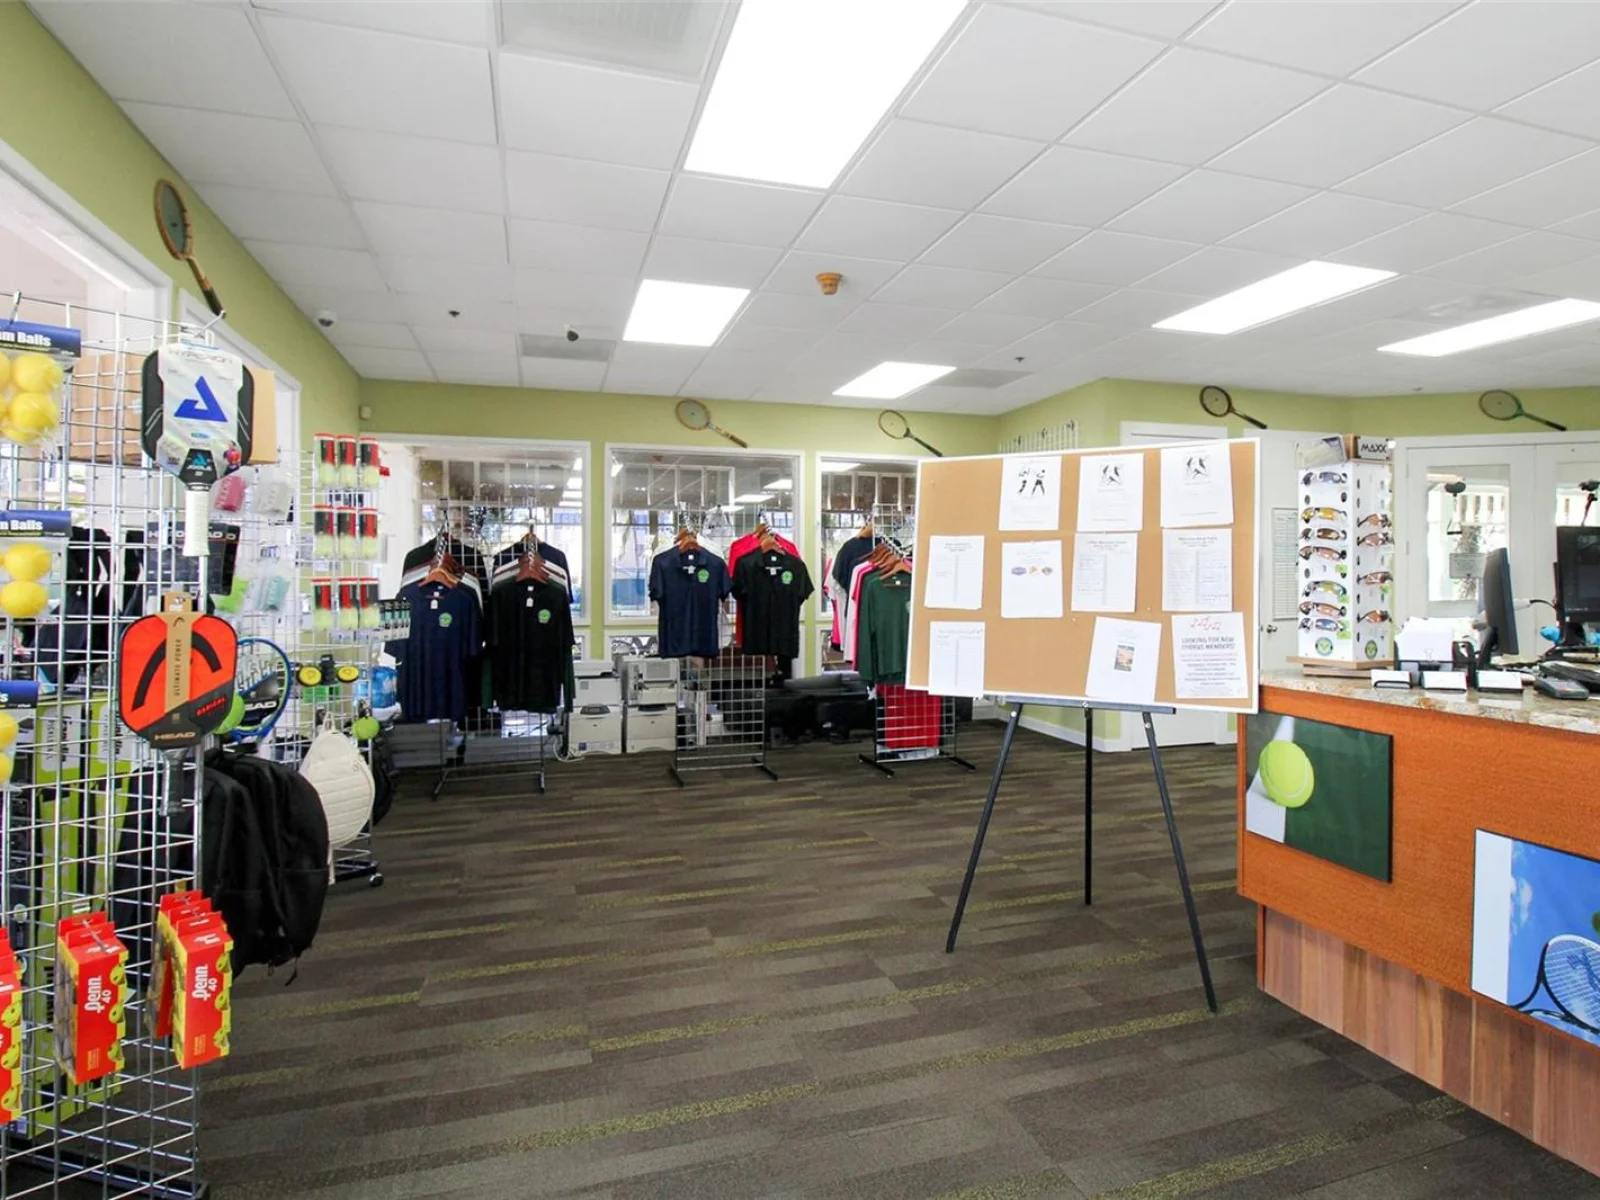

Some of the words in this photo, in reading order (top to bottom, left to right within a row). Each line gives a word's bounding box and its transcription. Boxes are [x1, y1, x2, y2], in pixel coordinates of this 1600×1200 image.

[17, 331, 52, 347] Balls
[1360, 443, 1387, 453] MAXX
[10, 519, 44, 531] Balls
[243, 700, 278, 711] EAD
[154, 731, 196, 740] HEAD
[208, 977, 218, 991] 40
[102, 989, 112, 1004] 40
